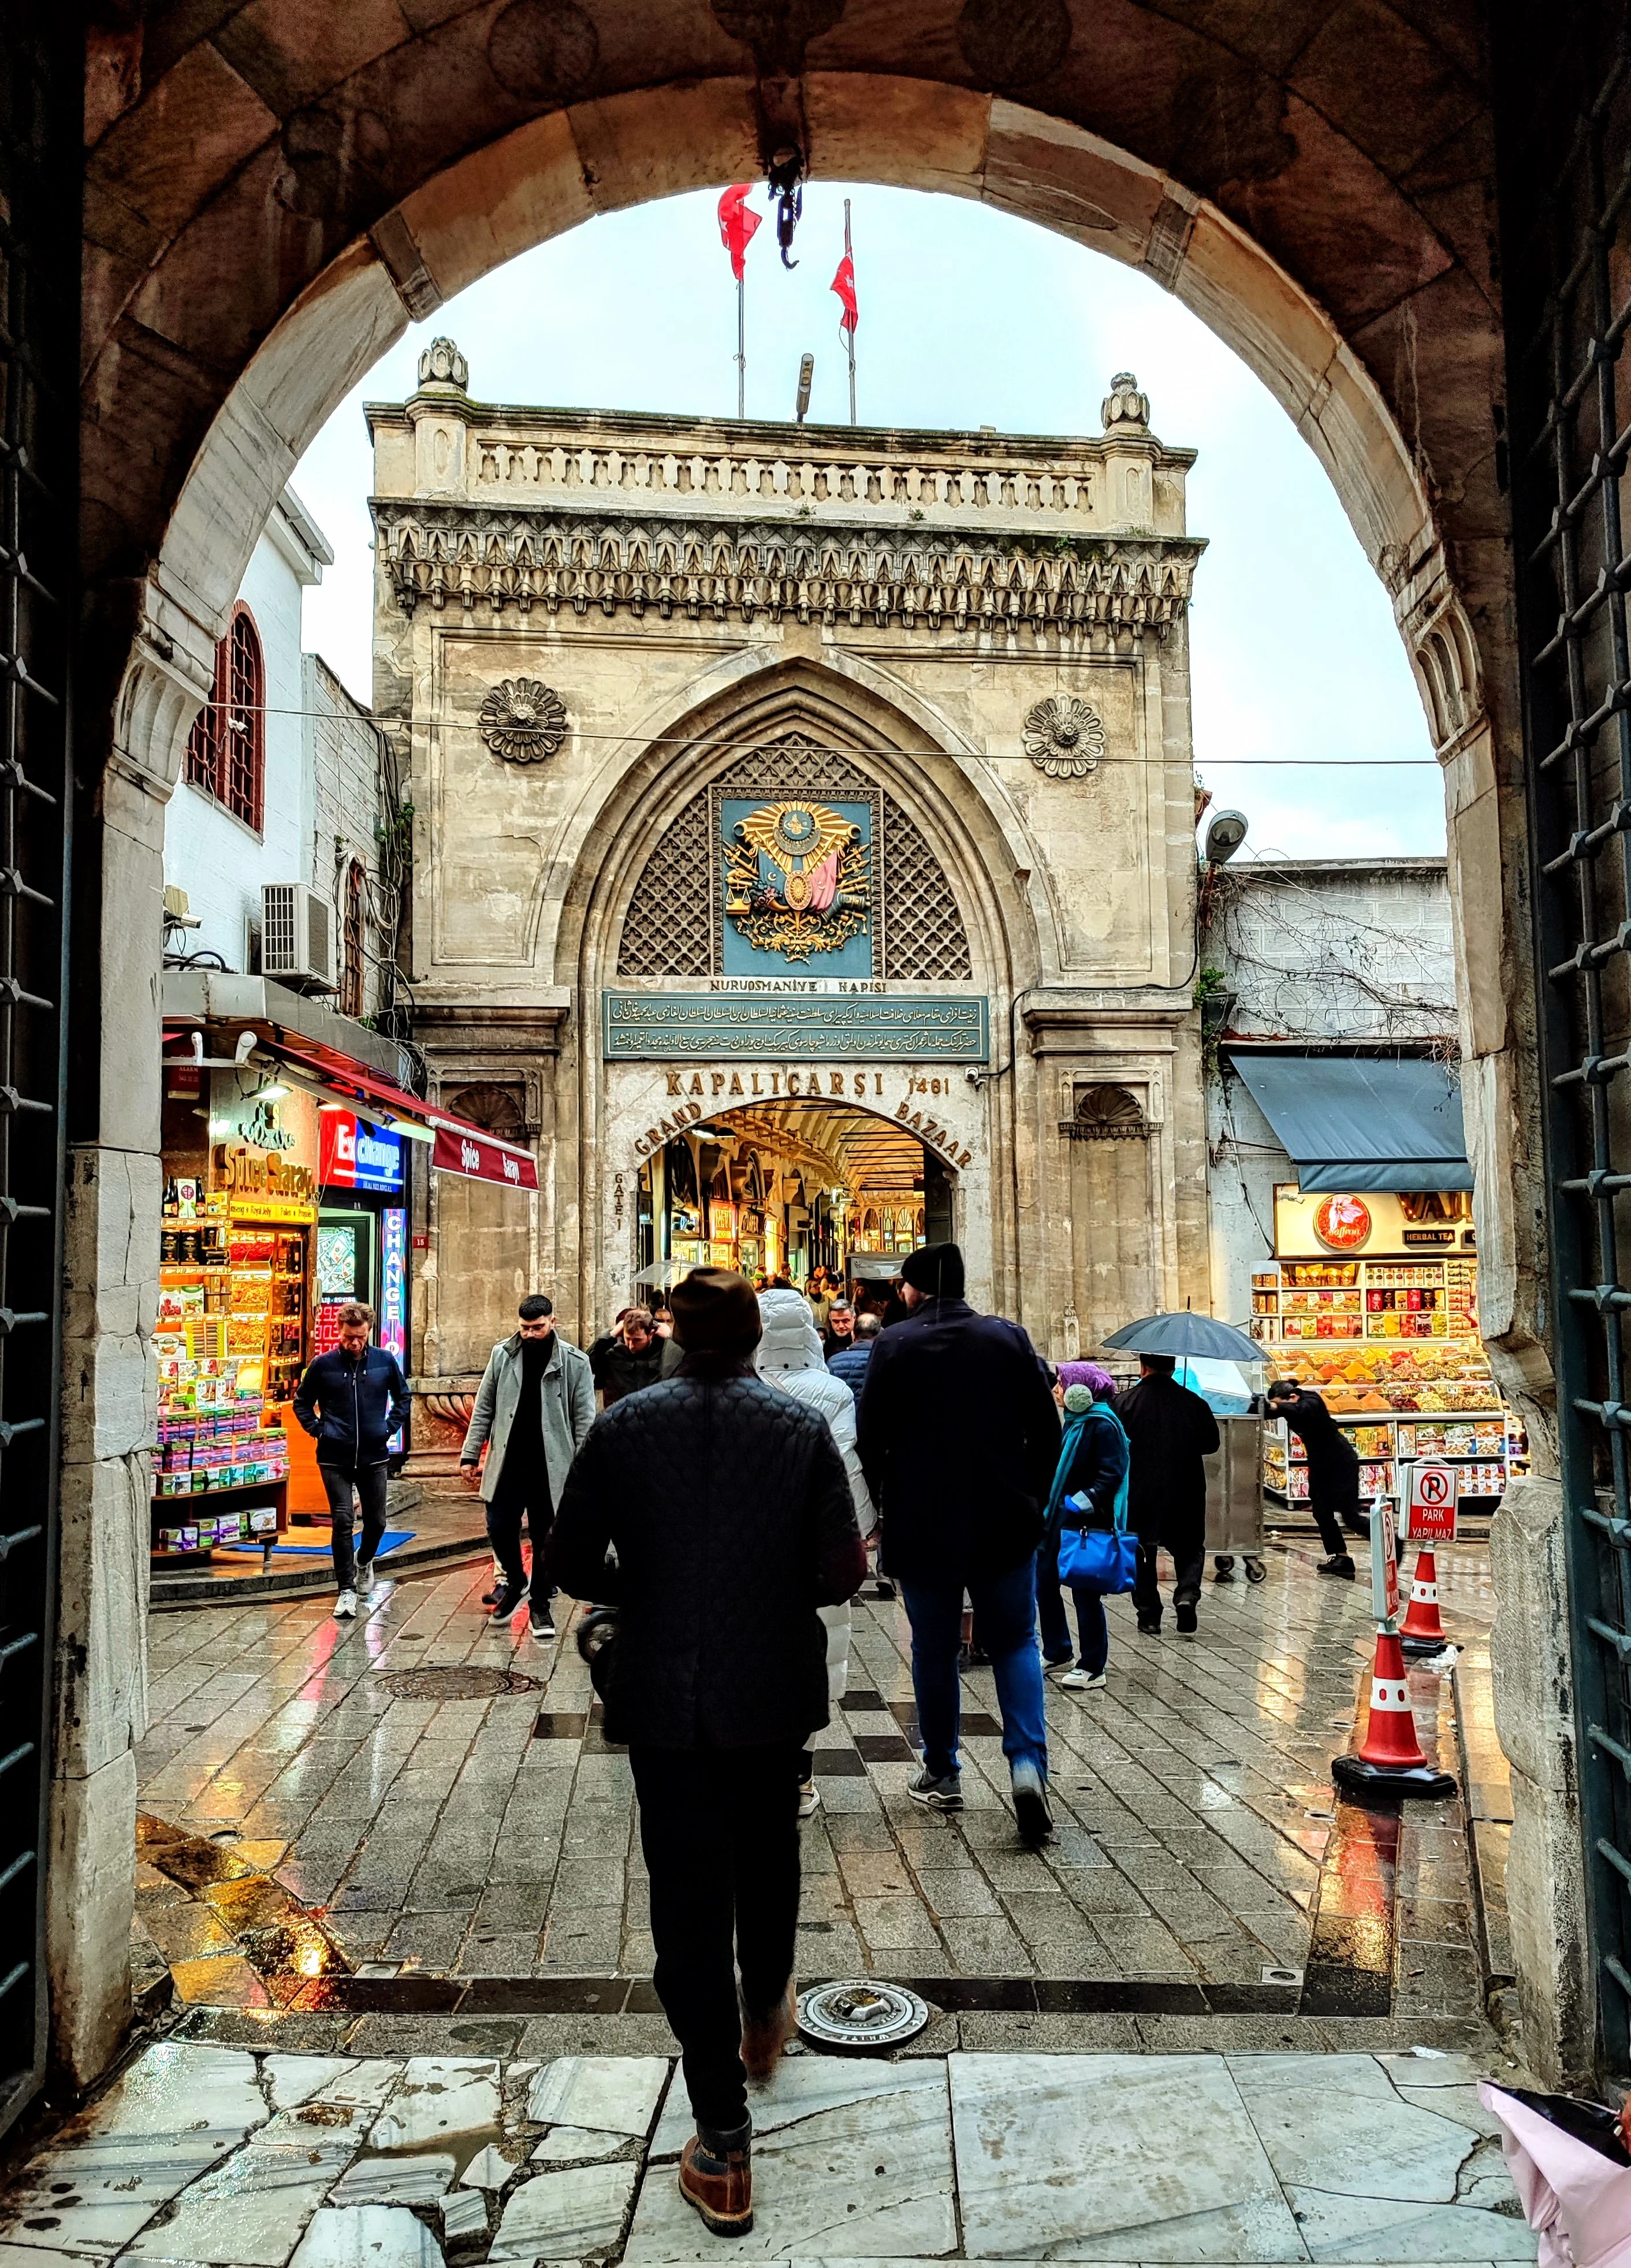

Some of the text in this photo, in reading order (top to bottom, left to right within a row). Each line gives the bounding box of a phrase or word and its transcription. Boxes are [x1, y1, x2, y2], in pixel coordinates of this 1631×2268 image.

[666, 1071, 882, 1097] KAPALIÇARŞI
[635, 1101, 702, 1155] GRAND
[895, 1101, 971, 1169] BAZAAR
[224, 1142, 267, 1194] Spice
[461, 1138, 479, 1173] Spice
[614, 1173, 624, 1215] GATE
[1438, 1232, 1454, 1241] TEA
[385, 1215, 401, 1320] CHANGE
[1412, 1526, 1451, 1540] YAPILMAZ
[1423, 1508, 1444, 1522] PARK
